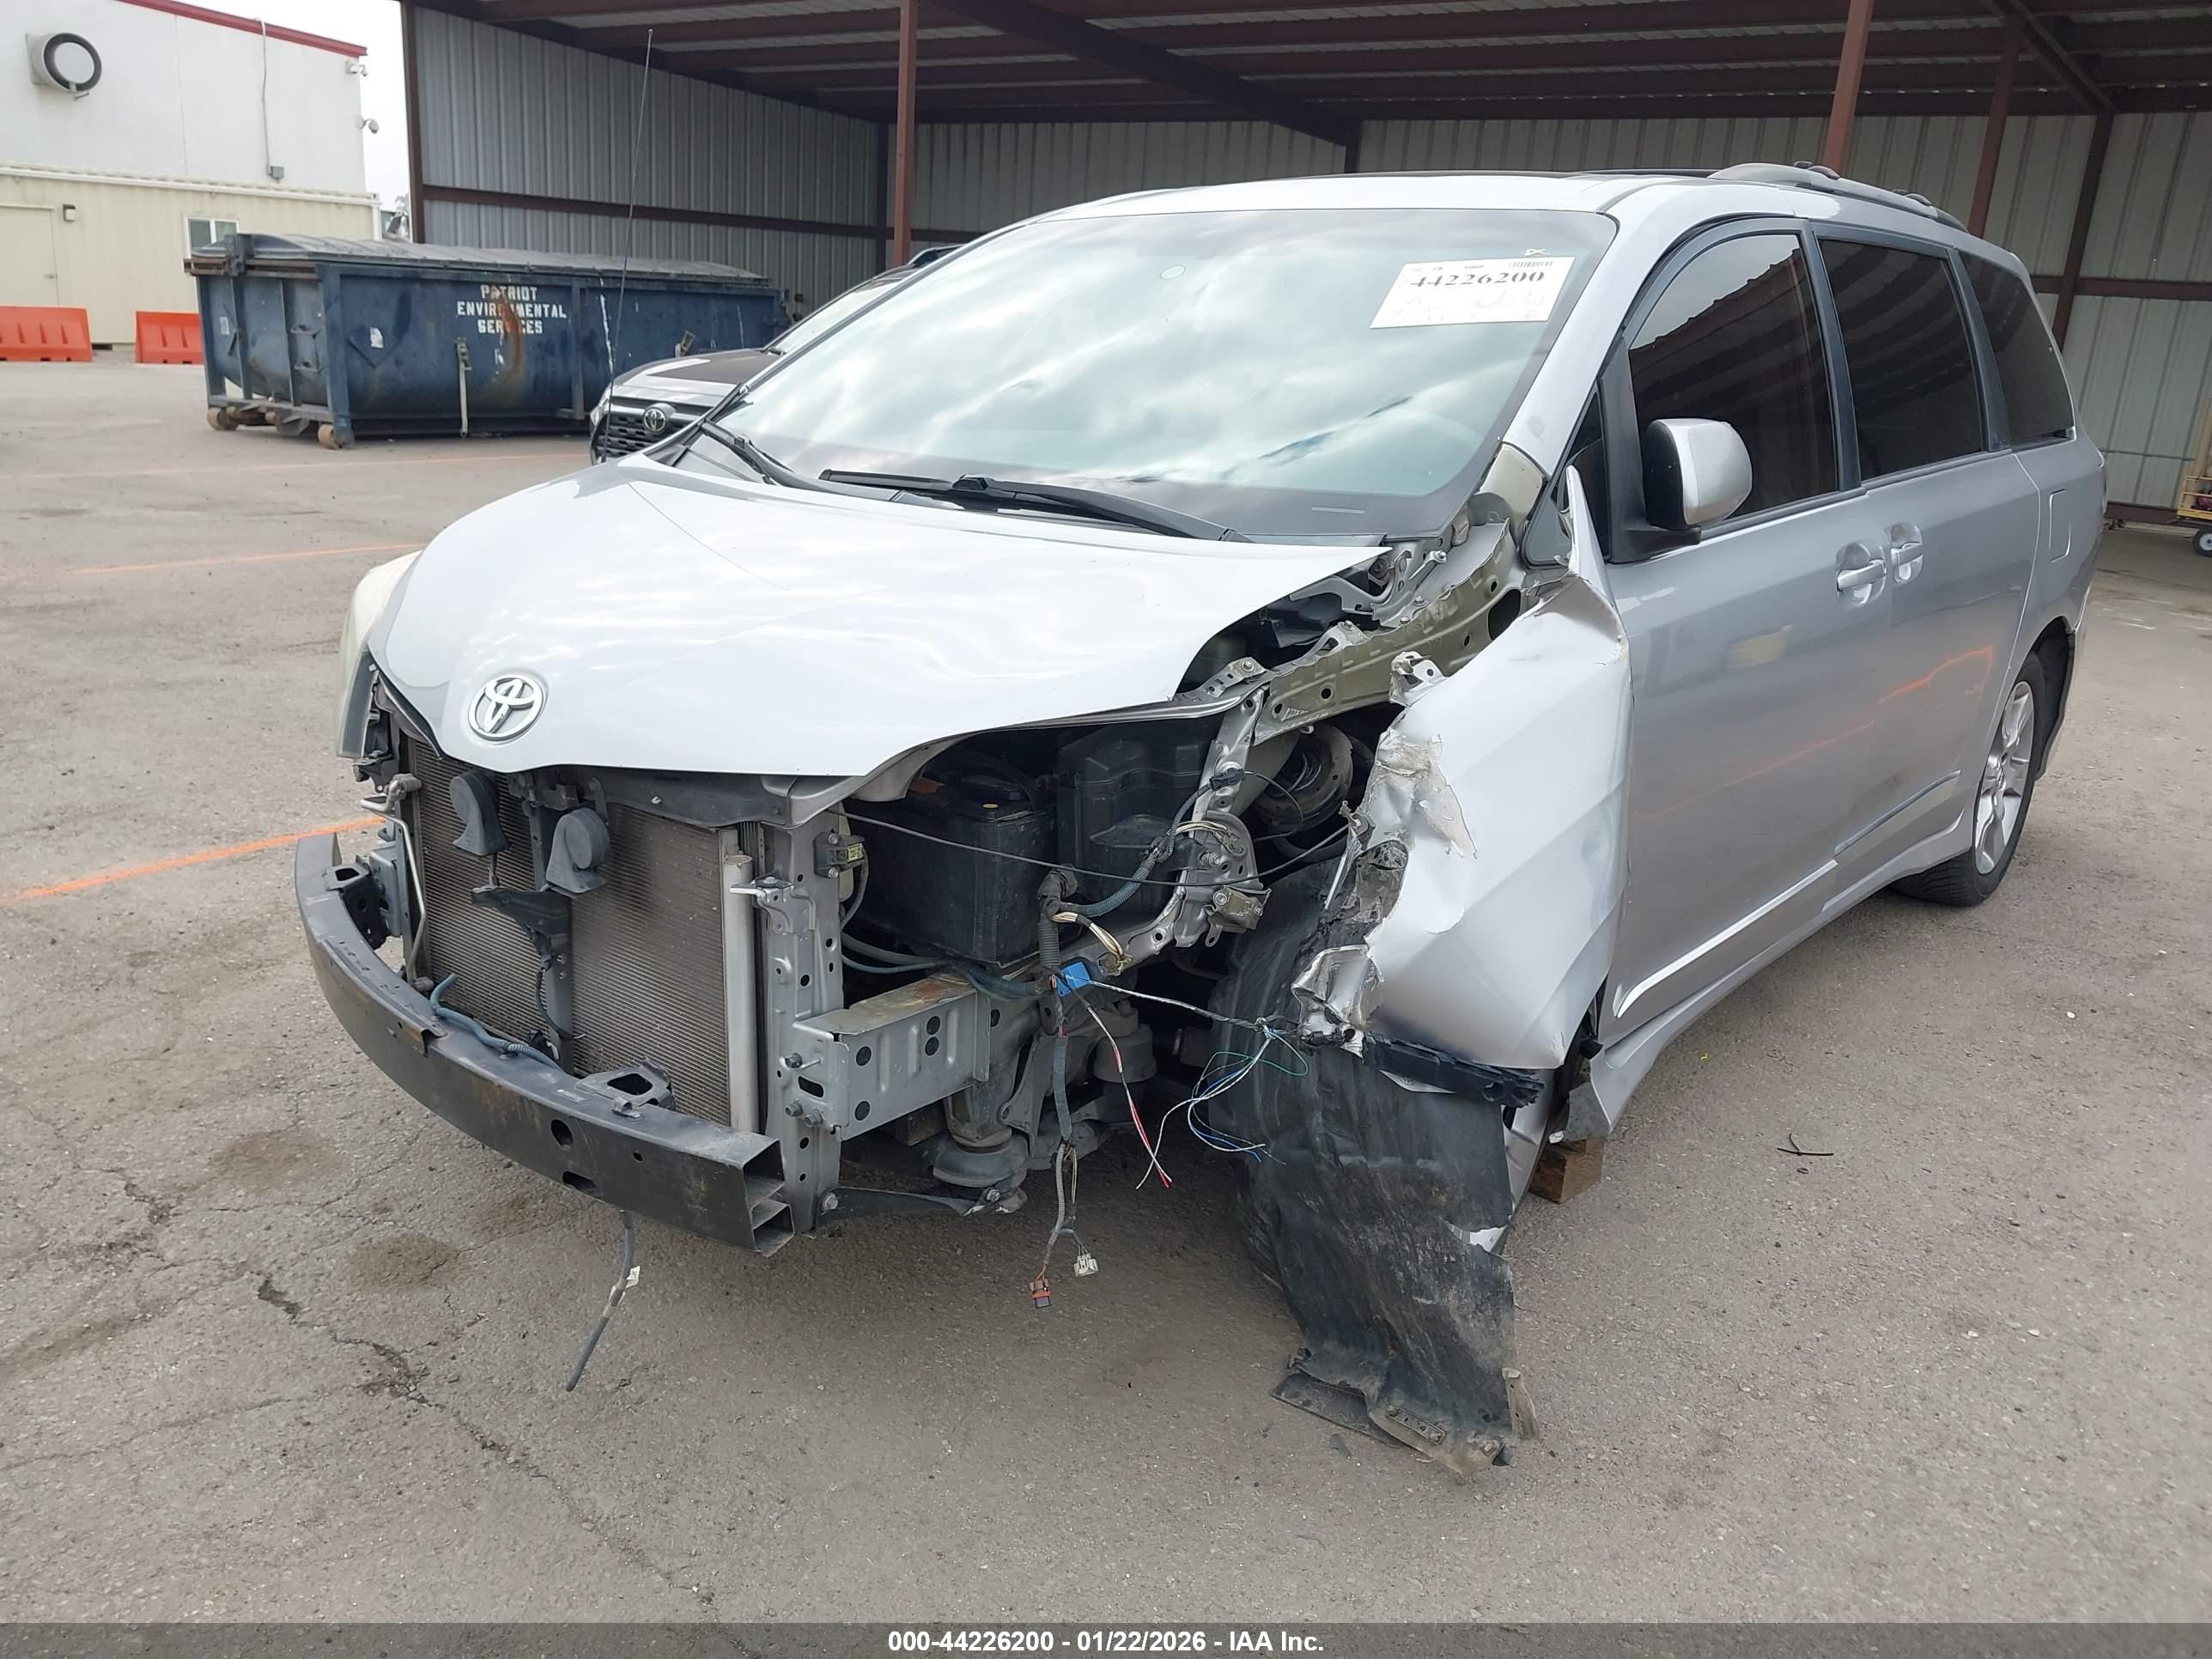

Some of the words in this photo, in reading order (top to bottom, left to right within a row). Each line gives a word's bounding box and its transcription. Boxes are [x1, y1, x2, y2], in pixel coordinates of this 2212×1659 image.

[1410, 271, 1545, 287] 44226200
[480, 284, 538, 301] PATRIOT
[477, 319, 543, 334] SERCES
